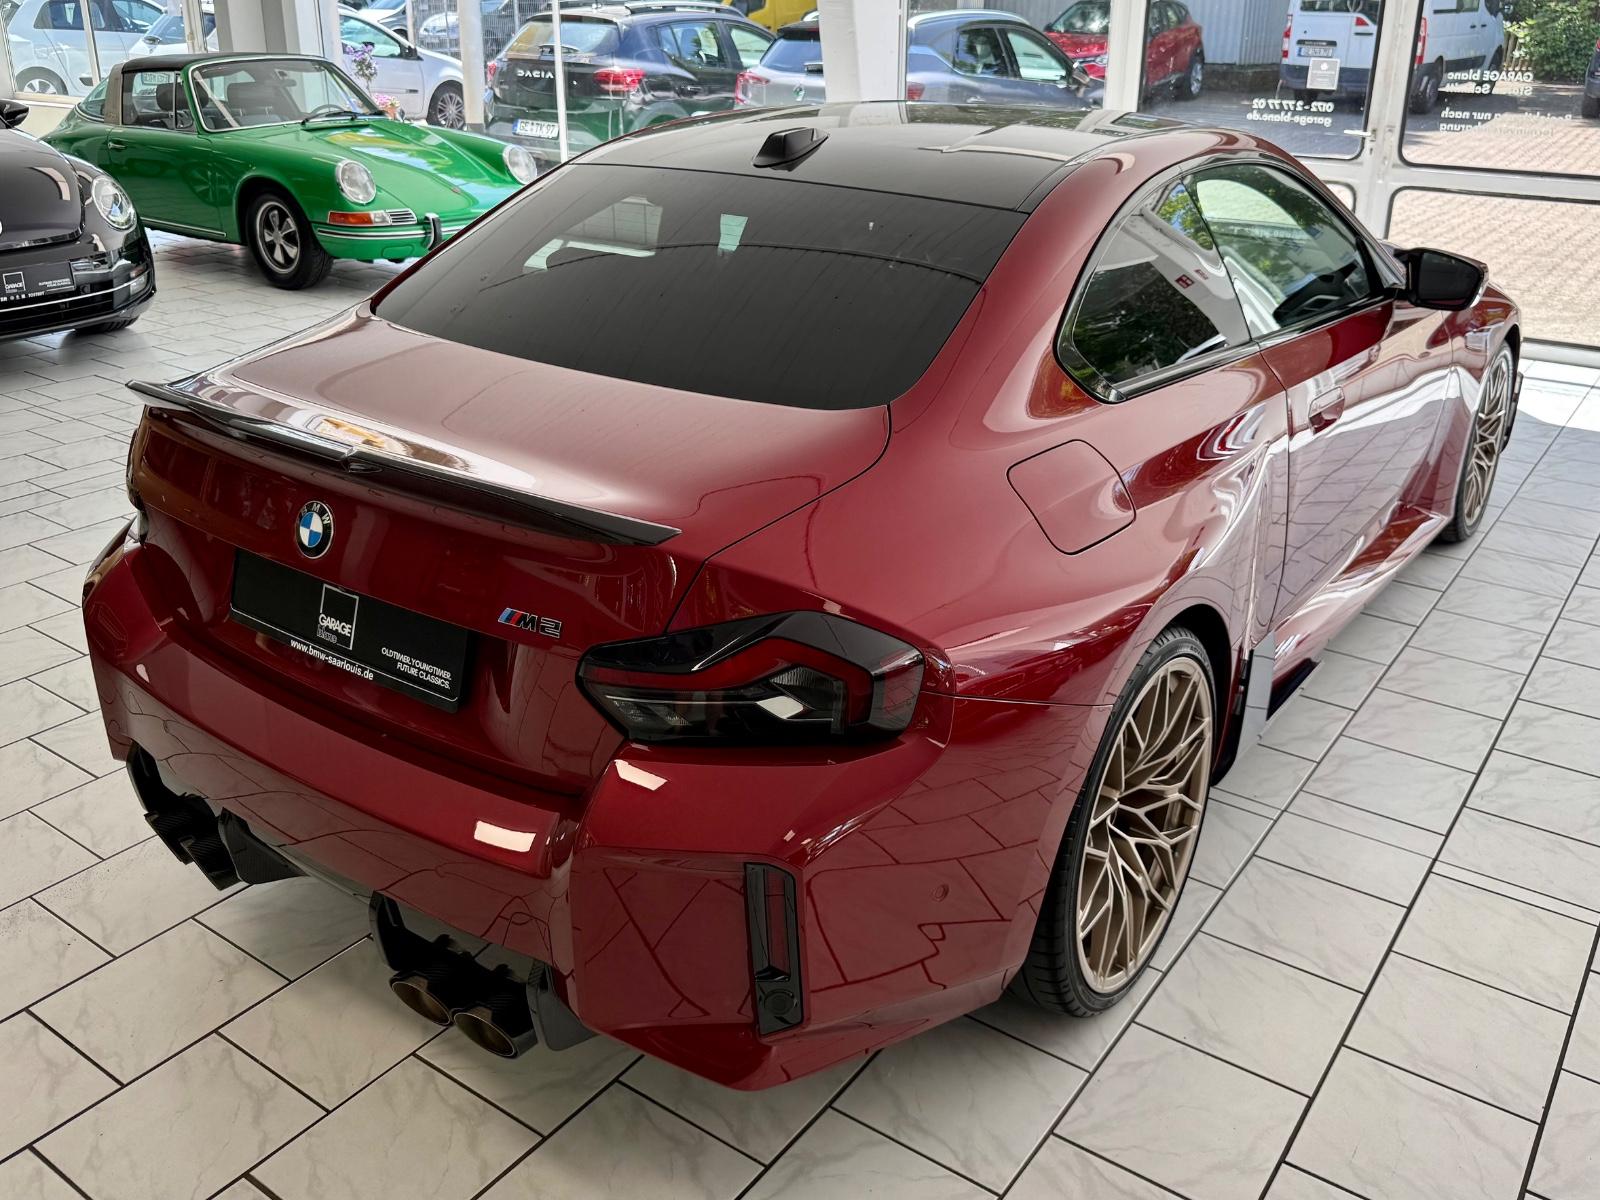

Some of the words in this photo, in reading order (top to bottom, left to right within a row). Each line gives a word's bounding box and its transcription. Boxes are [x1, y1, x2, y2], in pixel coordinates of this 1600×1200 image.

[516, 69, 555, 79] DACIA
[318, 613, 352, 637] GARAGE
[290, 639, 374, 681] www.bmw-saarlouis.de
[396, 661, 418, 677] FUTURE
